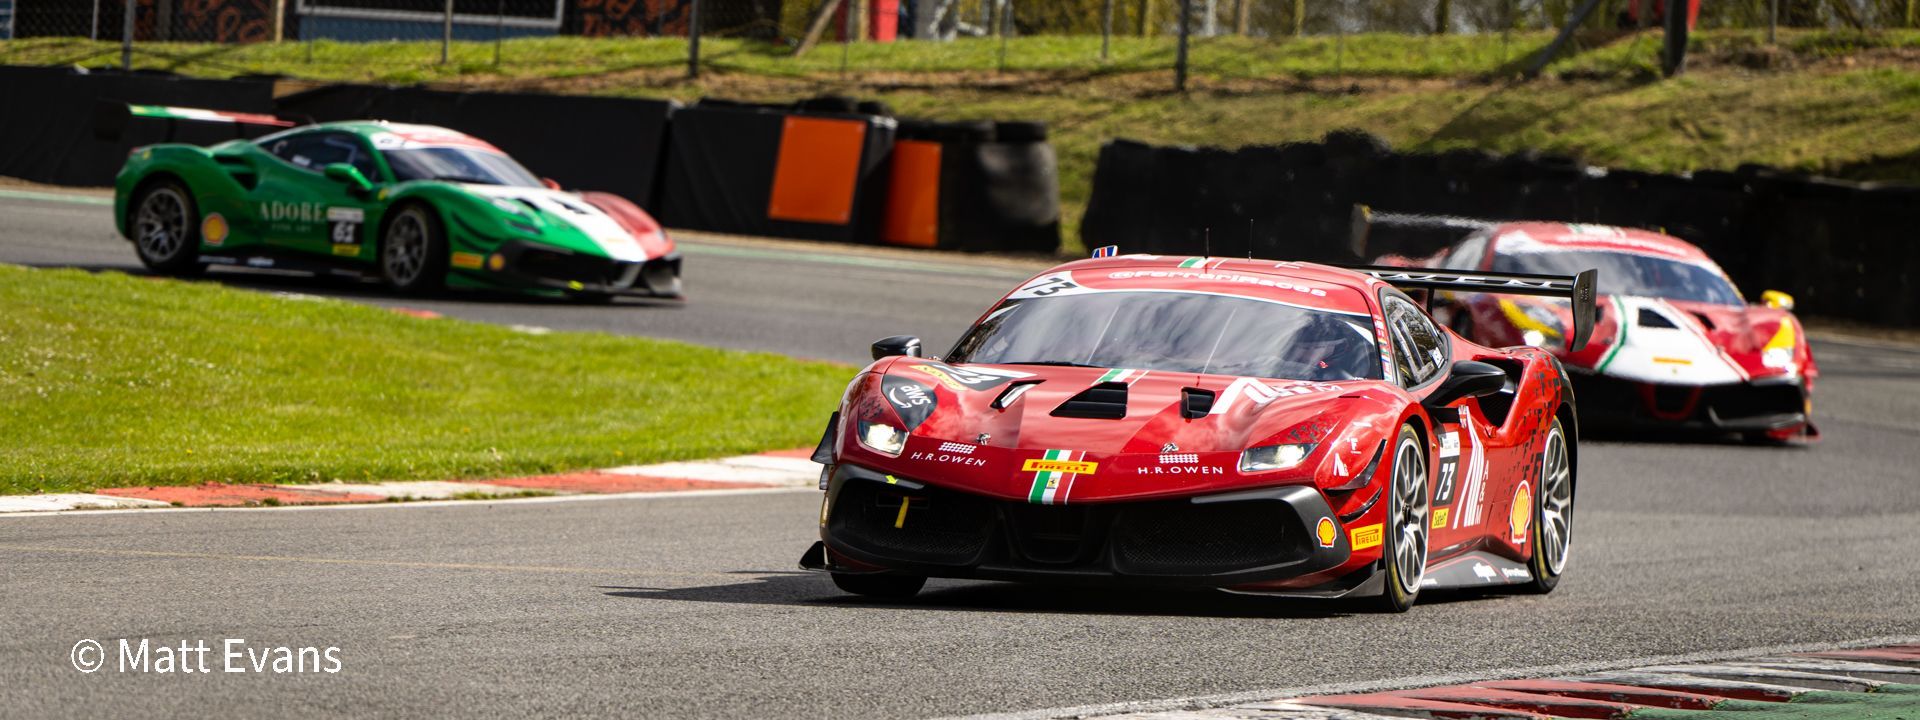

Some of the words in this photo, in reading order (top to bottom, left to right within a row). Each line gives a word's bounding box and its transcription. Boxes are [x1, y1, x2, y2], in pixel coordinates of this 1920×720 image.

[261, 200, 325, 222] ADORE
[1022, 277, 1078, 296] 73
[900, 384, 932, 406] aws
[911, 451, 987, 467] H.R.OWEN
[1031, 461, 1089, 473] PIRELLI
[1138, 465, 1224, 475] H.R.OWEN
[1436, 462, 1456, 501] 73
[1355, 528, 1379, 546] PIRELLI
